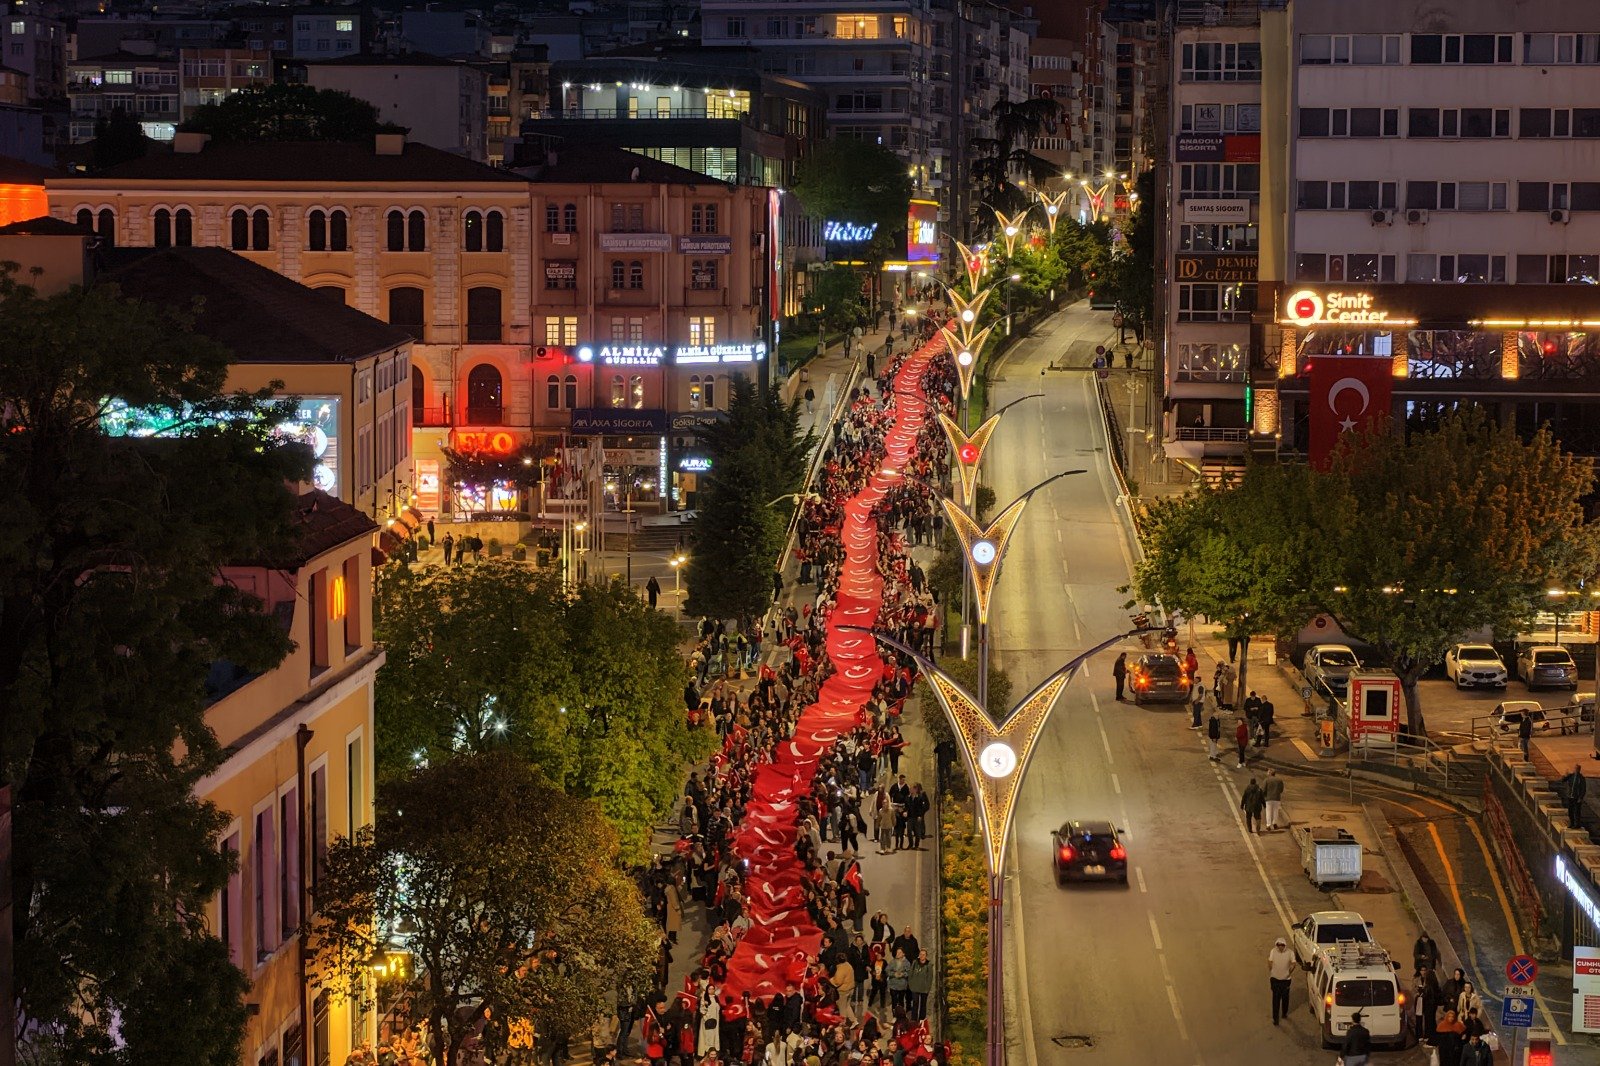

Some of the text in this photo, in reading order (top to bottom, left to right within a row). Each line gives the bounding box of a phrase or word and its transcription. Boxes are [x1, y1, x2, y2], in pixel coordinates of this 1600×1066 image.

[1215, 204, 1244, 212] SİGORTA
[602, 239, 628, 247] SAMSUN
[1217, 256, 1258, 267] DEMİR
[1326, 292, 1371, 309] Simit
[1326, 308, 1388, 323] Center
[600, 345, 663, 357] ALMİLA
[676, 345, 709, 357] ALMİLA
[590, 418, 611, 427] AXA
[612, 418, 654, 428] SİGORTA
